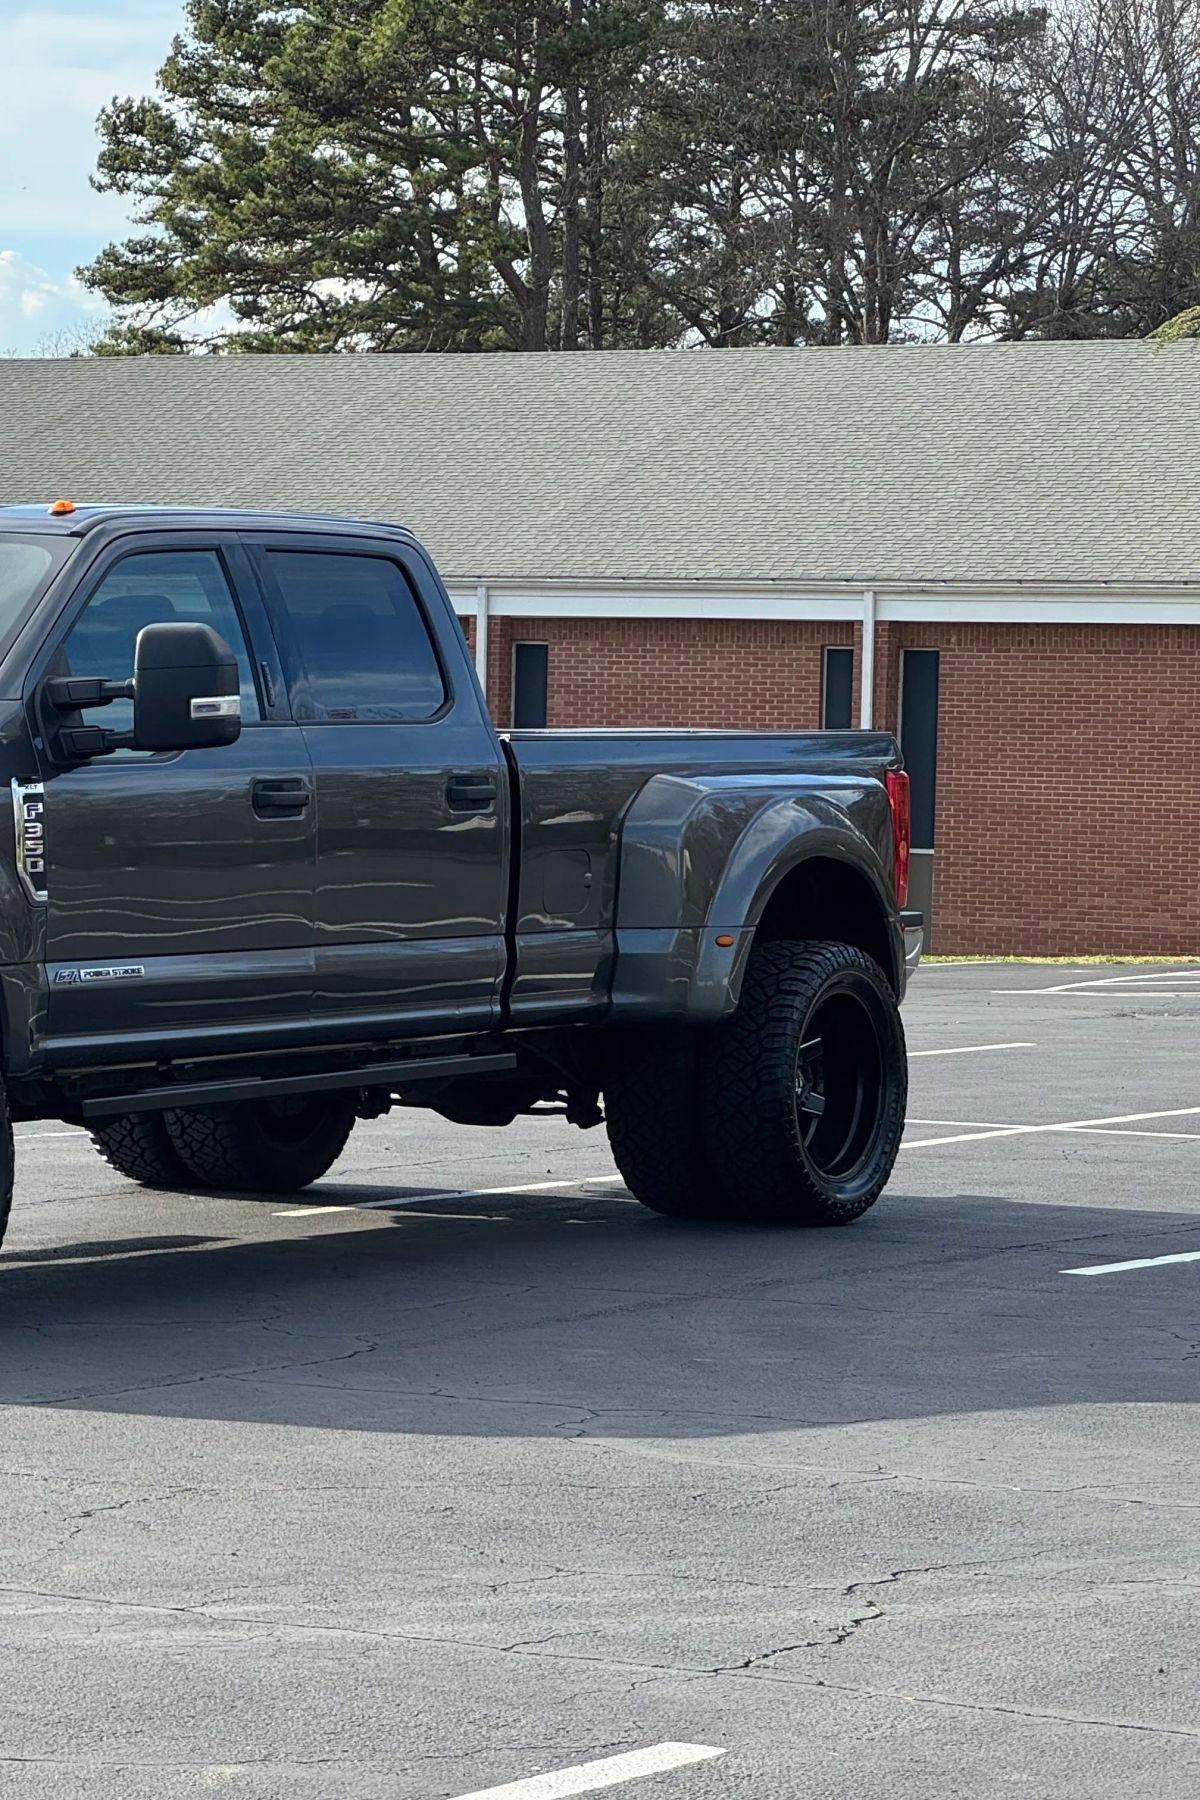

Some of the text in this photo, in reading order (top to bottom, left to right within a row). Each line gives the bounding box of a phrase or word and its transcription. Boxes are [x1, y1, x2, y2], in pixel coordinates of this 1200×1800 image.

[23, 802, 44, 872] F350
[83, 969, 110, 978] POWER
[112, 967, 143, 976] STROKE
